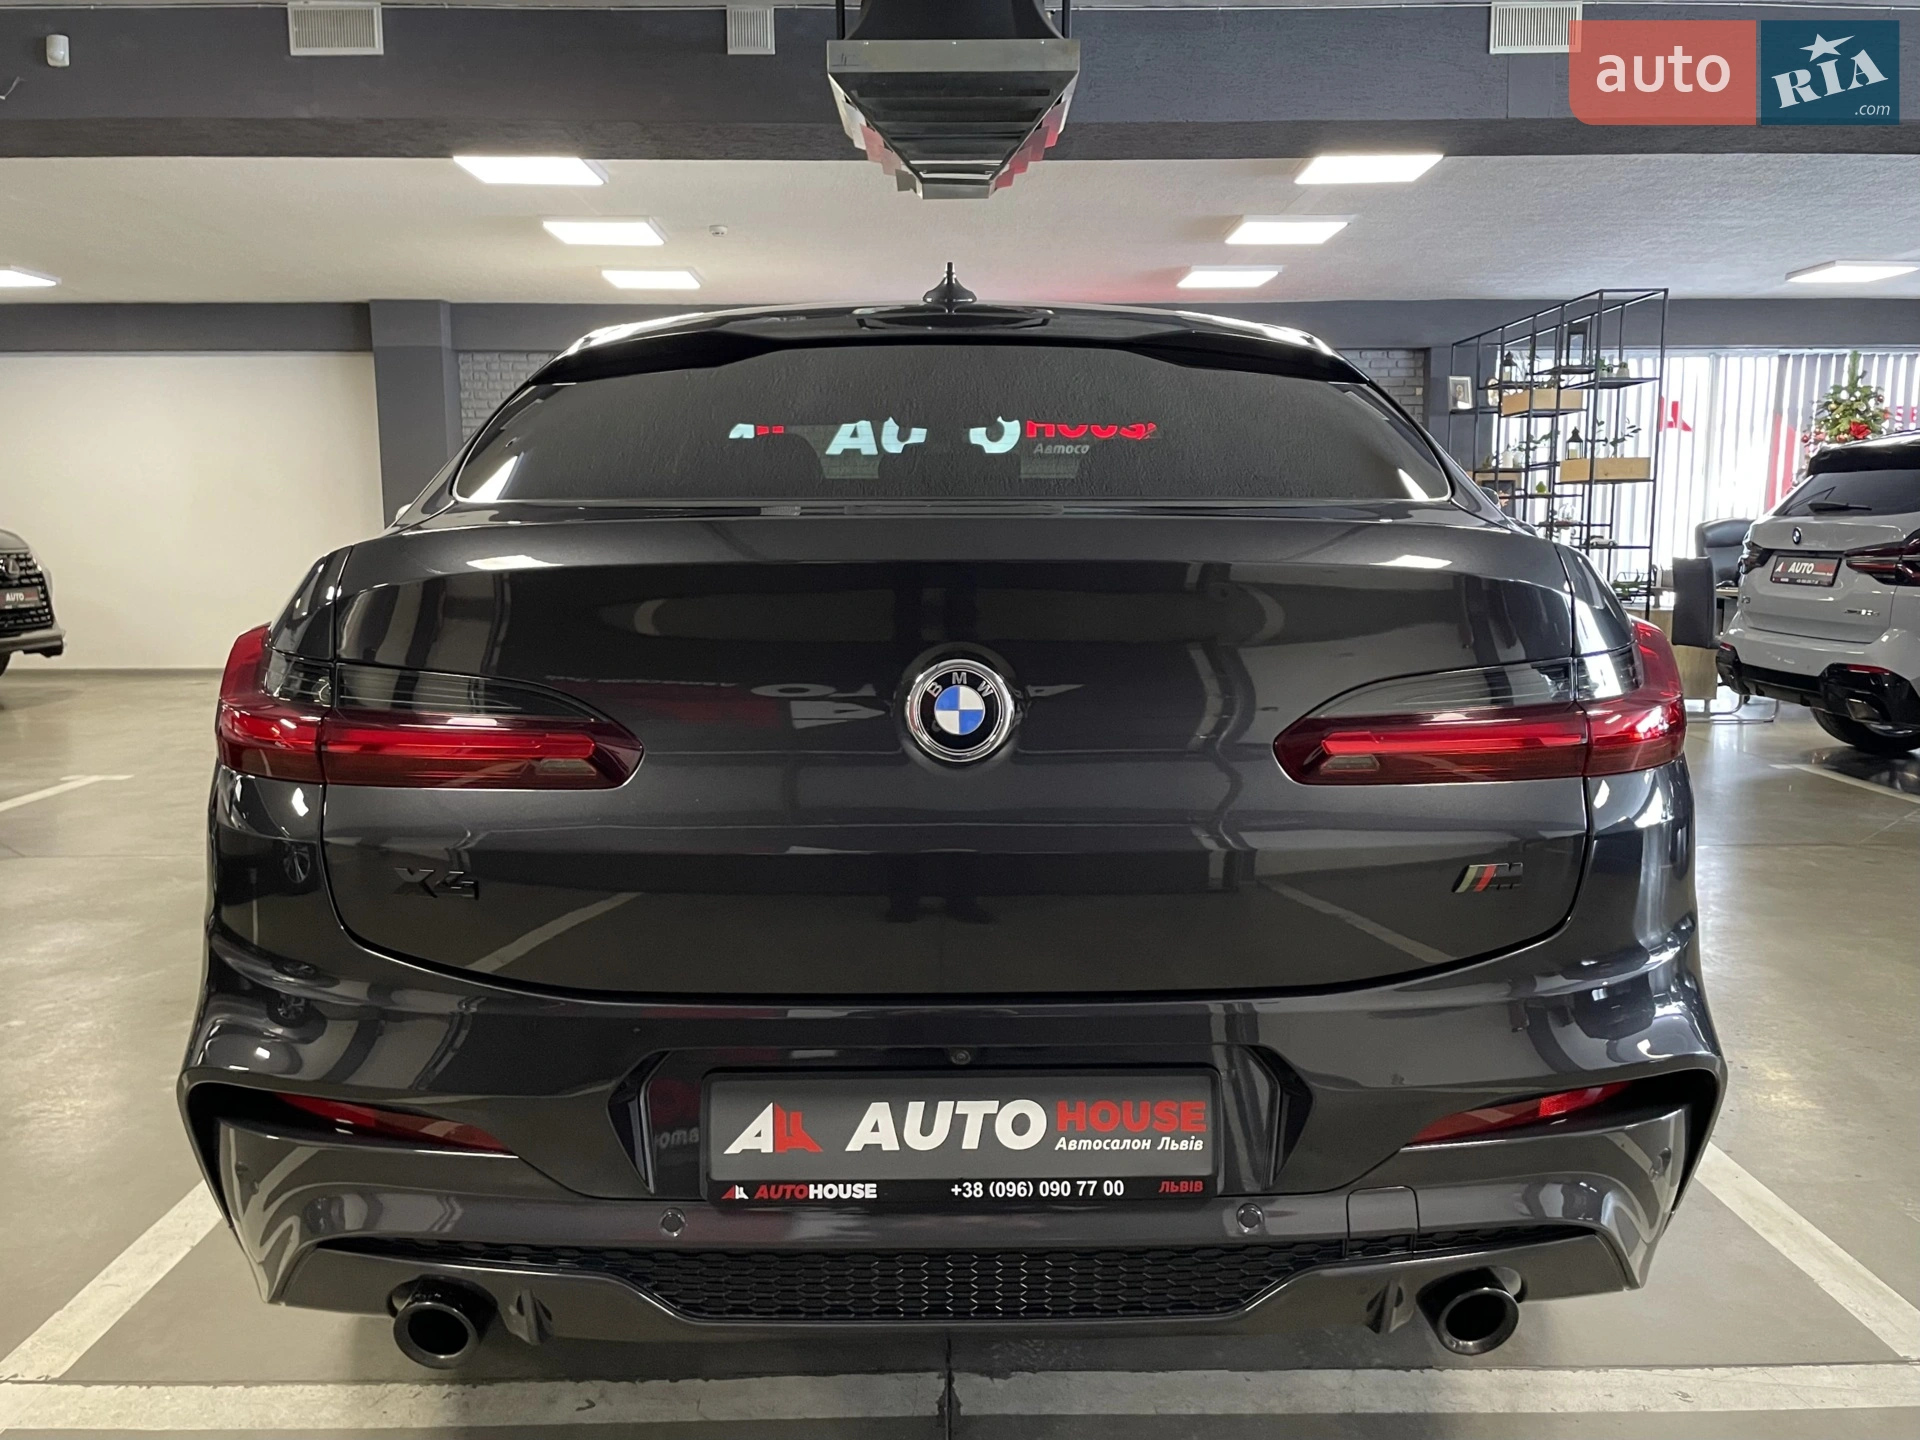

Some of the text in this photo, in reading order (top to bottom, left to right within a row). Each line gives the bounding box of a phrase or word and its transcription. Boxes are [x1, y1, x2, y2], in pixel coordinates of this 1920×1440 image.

[1788, 561, 1814, 574] AUTO
[926, 671, 994, 698] BMW
[845, 1099, 1047, 1150] AUTO
[1056, 1099, 1207, 1132] HOUSE
[1055, 1136, 1204, 1151] Автосалон Львів
[754, 1183, 878, 1200] AUTOHOUSE
[950, 1180, 1125, 1199] +38 (096) 090 77 00
